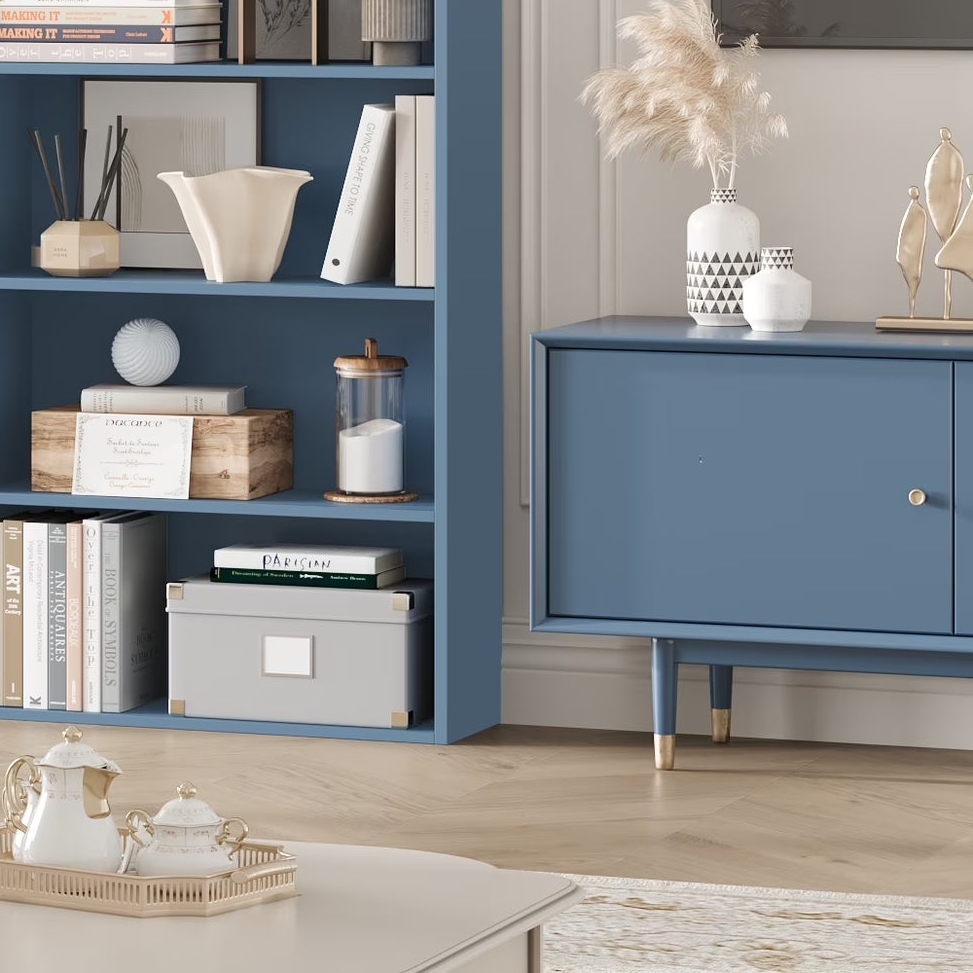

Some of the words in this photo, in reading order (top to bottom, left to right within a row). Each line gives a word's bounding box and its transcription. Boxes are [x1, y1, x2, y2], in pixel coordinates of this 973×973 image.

[1, 10, 46, 21] MAKING
[47, 10, 61, 21] IT
[45, 27, 59, 39] IT
[262, 553, 331, 571] PARISIAN
[5, 563, 21, 595] ART
[105, 569, 117, 605] BOOK
[53, 570, 66, 663] ANTIQUAIRES
[105, 620, 117, 687] SYMBOLS
